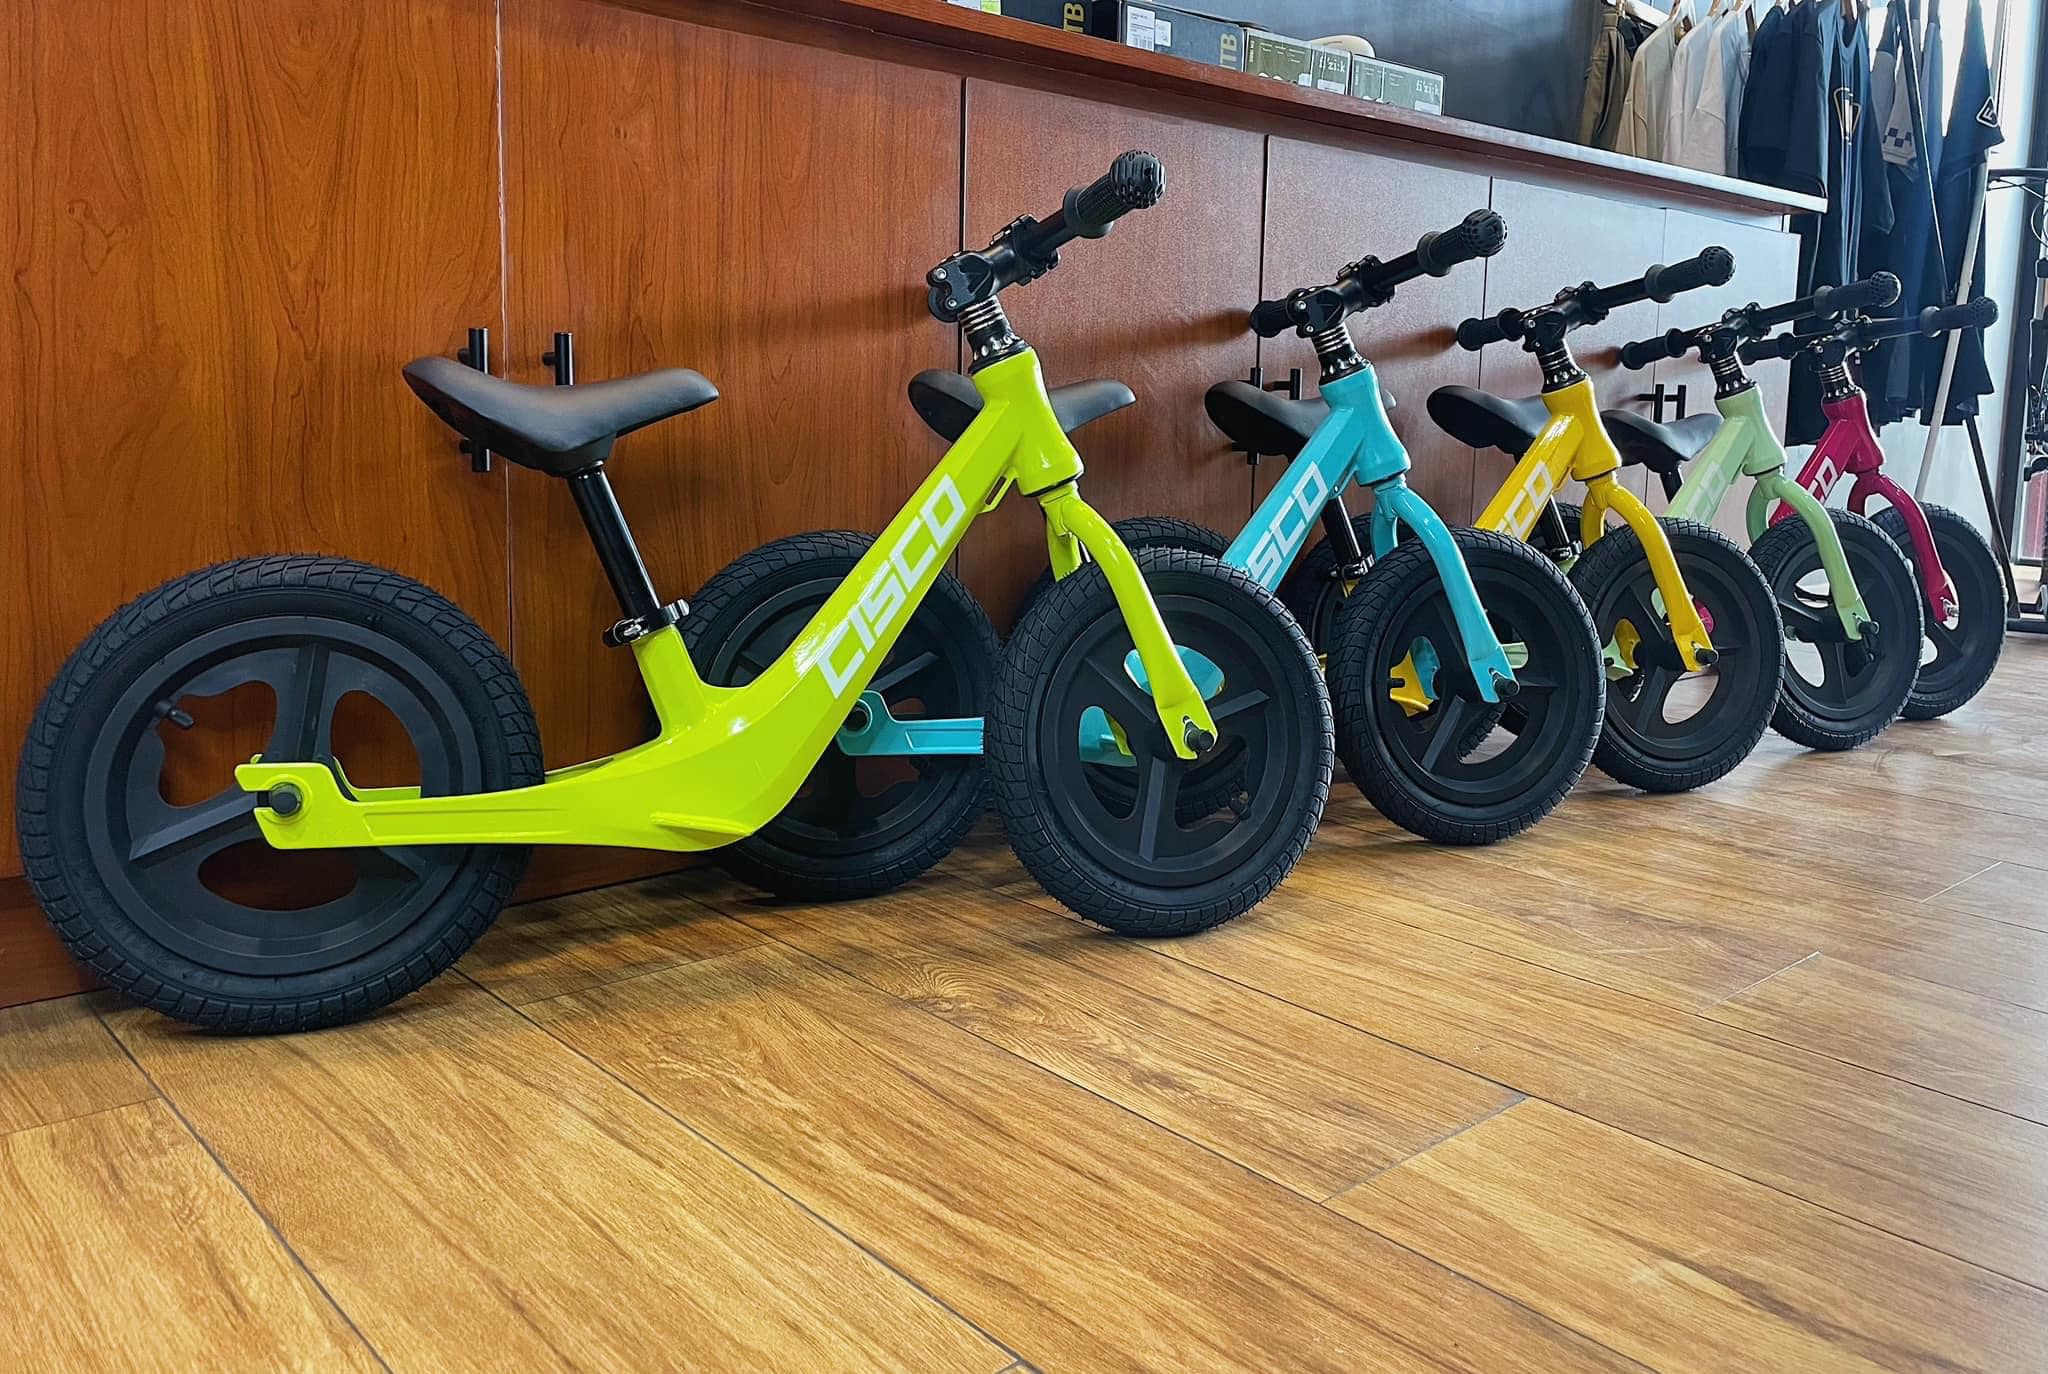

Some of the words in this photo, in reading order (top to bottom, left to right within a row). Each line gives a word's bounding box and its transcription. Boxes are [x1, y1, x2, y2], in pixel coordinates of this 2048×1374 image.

[1246, 461, 1329, 588] SCO
[1496, 460, 1553, 540] CO
[816, 473, 967, 699] CISCO
